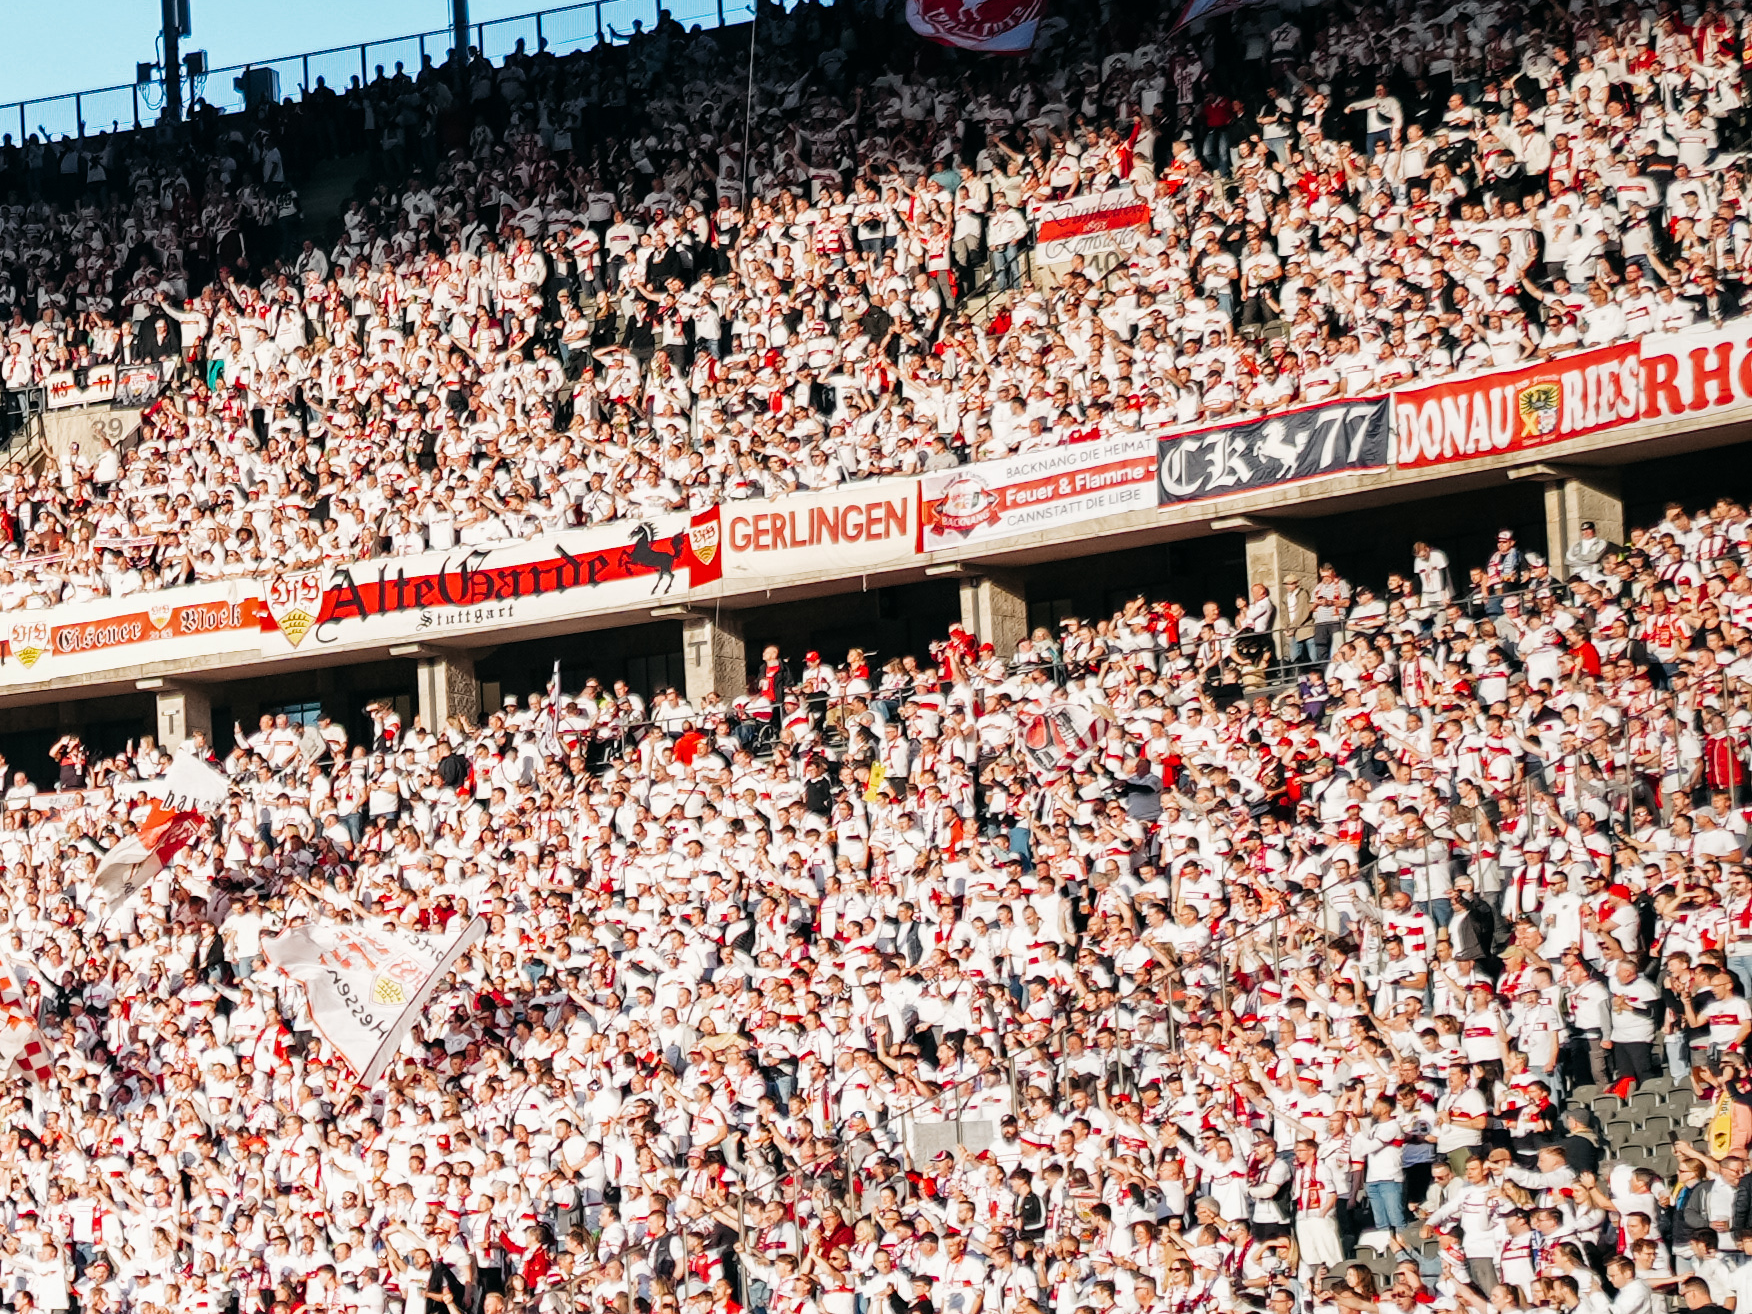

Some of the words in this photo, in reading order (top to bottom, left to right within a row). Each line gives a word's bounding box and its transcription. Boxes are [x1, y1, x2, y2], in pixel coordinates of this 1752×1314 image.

[1397, 386, 1517, 464] DONAU
[1561, 354, 1642, 434] RIES
[1005, 453, 1078, 479] BACKNANG
[1079, 448, 1101, 463] DIE
[1111, 438, 1153, 457] HEIMAT
[1316, 403, 1377, 468] 77
[1005, 485, 1053, 506] Feuer
[1057, 479, 1072, 496] &
[1074, 464, 1144, 490] Flamme
[1007, 501, 1084, 526] CANNSTATT
[1085, 496, 1105, 512] DIE
[1107, 489, 1141, 504] LIEBE
[729, 497, 909, 554] GERLINGEN
[315, 563, 435, 644] Alte
[439, 544, 611, 609] Garde
[415, 604, 515, 632] Stuttgart
